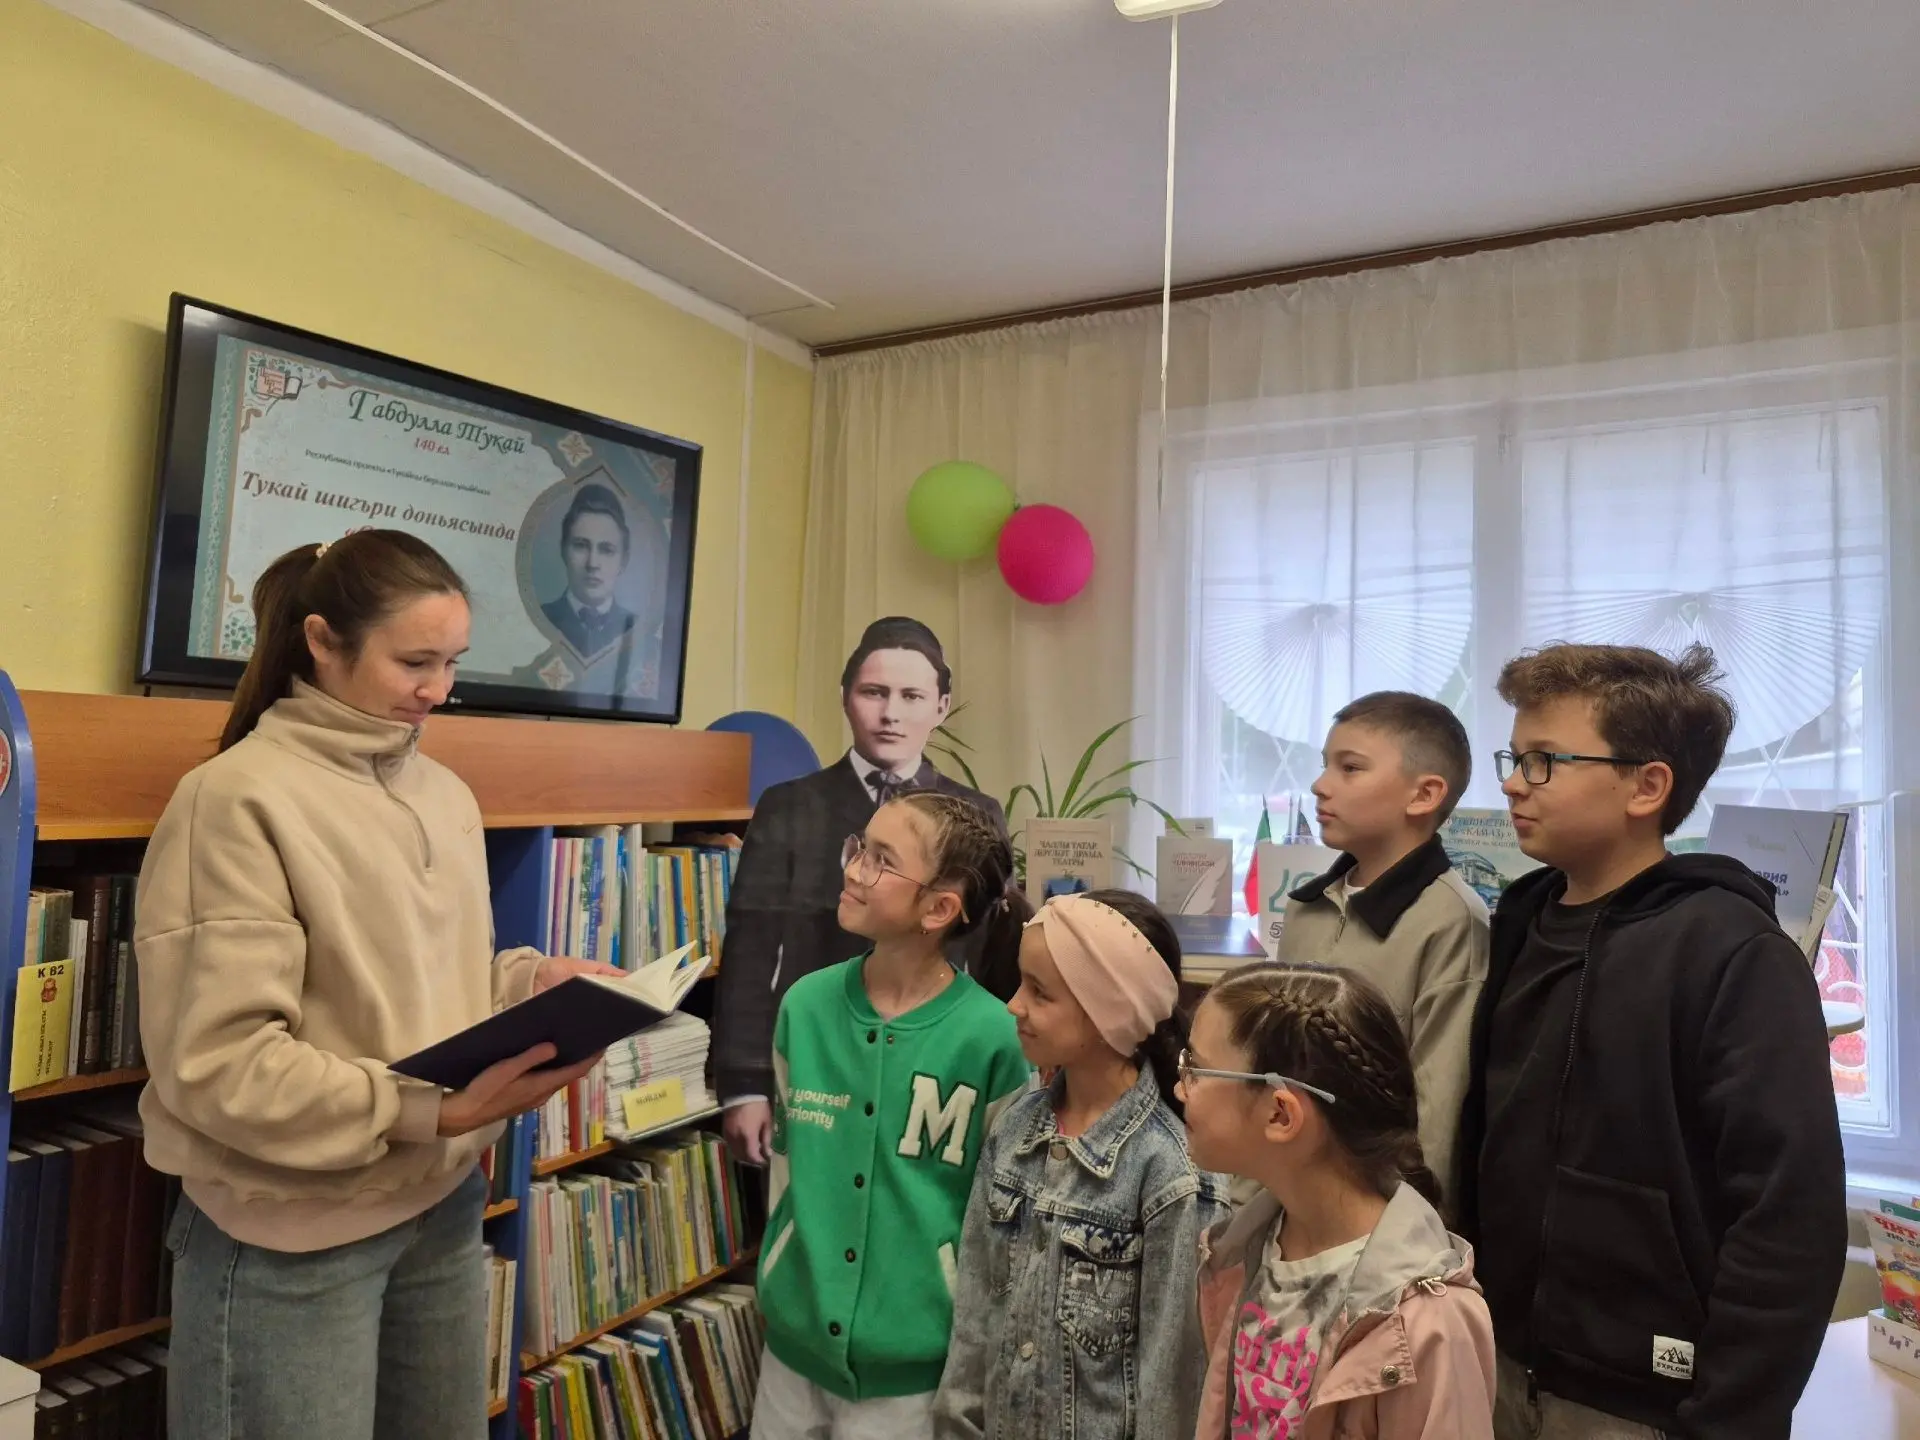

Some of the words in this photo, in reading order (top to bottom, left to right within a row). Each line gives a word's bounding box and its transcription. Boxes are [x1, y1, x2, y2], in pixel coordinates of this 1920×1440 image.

[349, 389, 453, 435] Габдулла
[457, 421, 525, 454] Тукай
[414, 437, 435, 450] 140
[241, 470, 307, 501] Тукай
[314, 489, 397, 519] шигъри
[793, 1088, 851, 1110] yourself
[897, 1070, 978, 1167] M
[1656, 1361, 1690, 1374] EXPLORE
